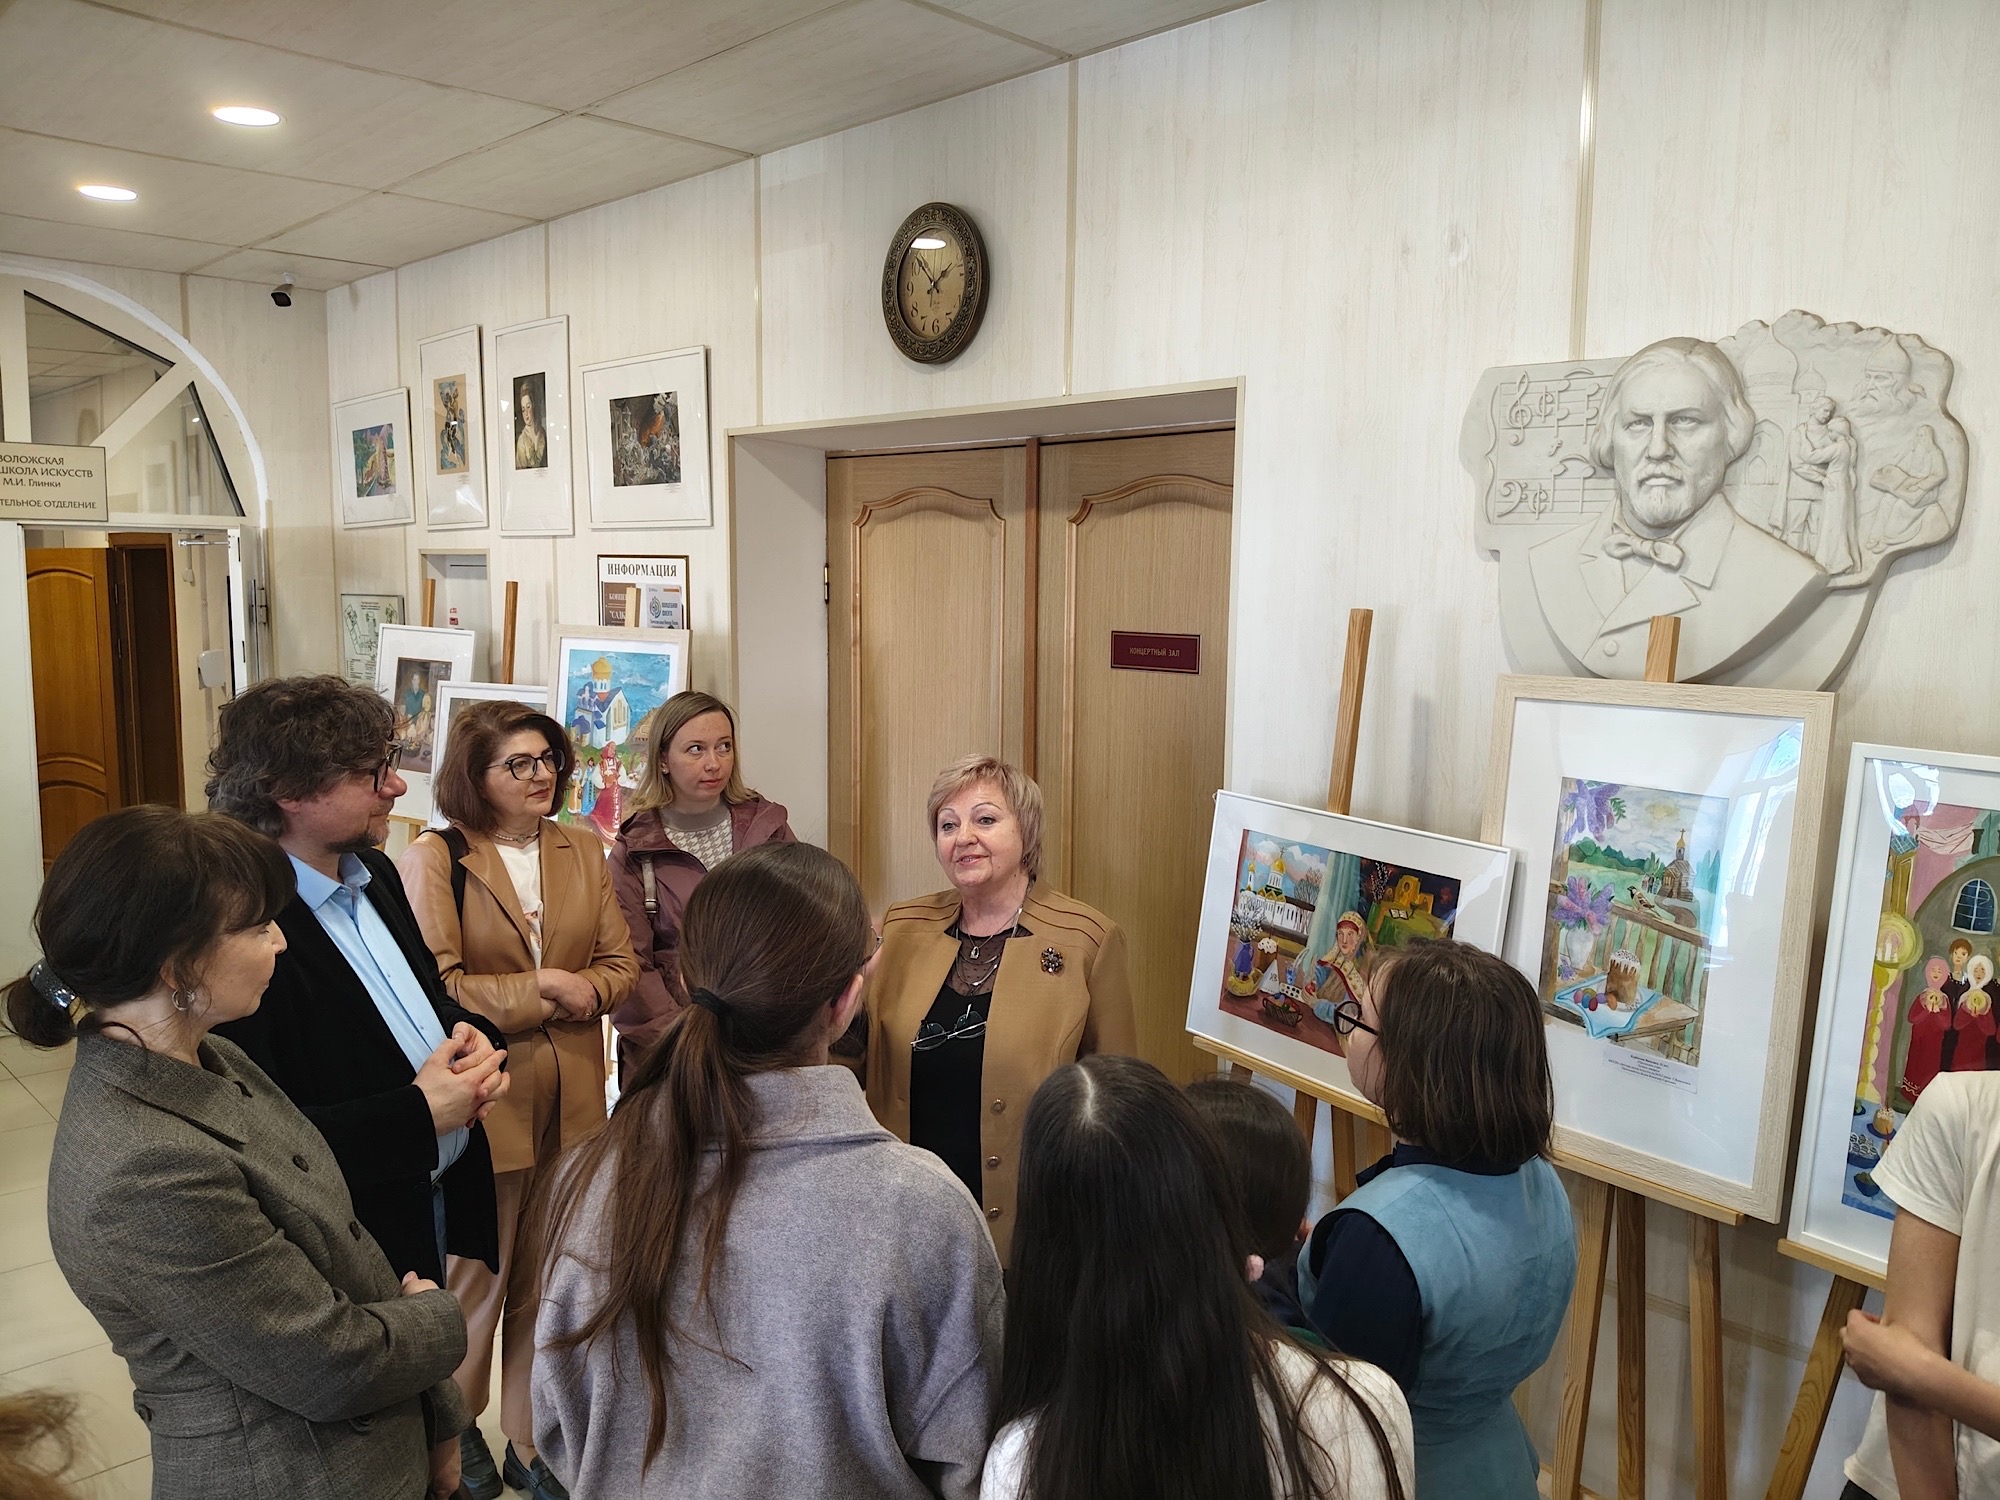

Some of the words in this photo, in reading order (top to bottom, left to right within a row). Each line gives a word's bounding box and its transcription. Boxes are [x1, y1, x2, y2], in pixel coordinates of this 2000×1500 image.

[907, 281, 914, 296] 9
[911, 301, 919, 318] 8
[920, 315, 928, 331] 7
[932, 318, 940, 334] 6
[0, 466, 39, 475] ШКОЛА
[41, 468, 93, 478] ИСКУССТВ
[3, 477, 26, 486] М.И.
[28, 478, 61, 488] Глинки
[0, 498, 41, 507] ТЕЛЬНОЕ
[44, 500, 97, 509] ОТДЕЛЕНИЕ
[607, 563, 677, 578] ИНФОРМАЦИЯ
[1129, 647, 1167, 656] КОНЦЕРТНЫЙ
[1168, 649, 1180, 657] ЗАЛ
